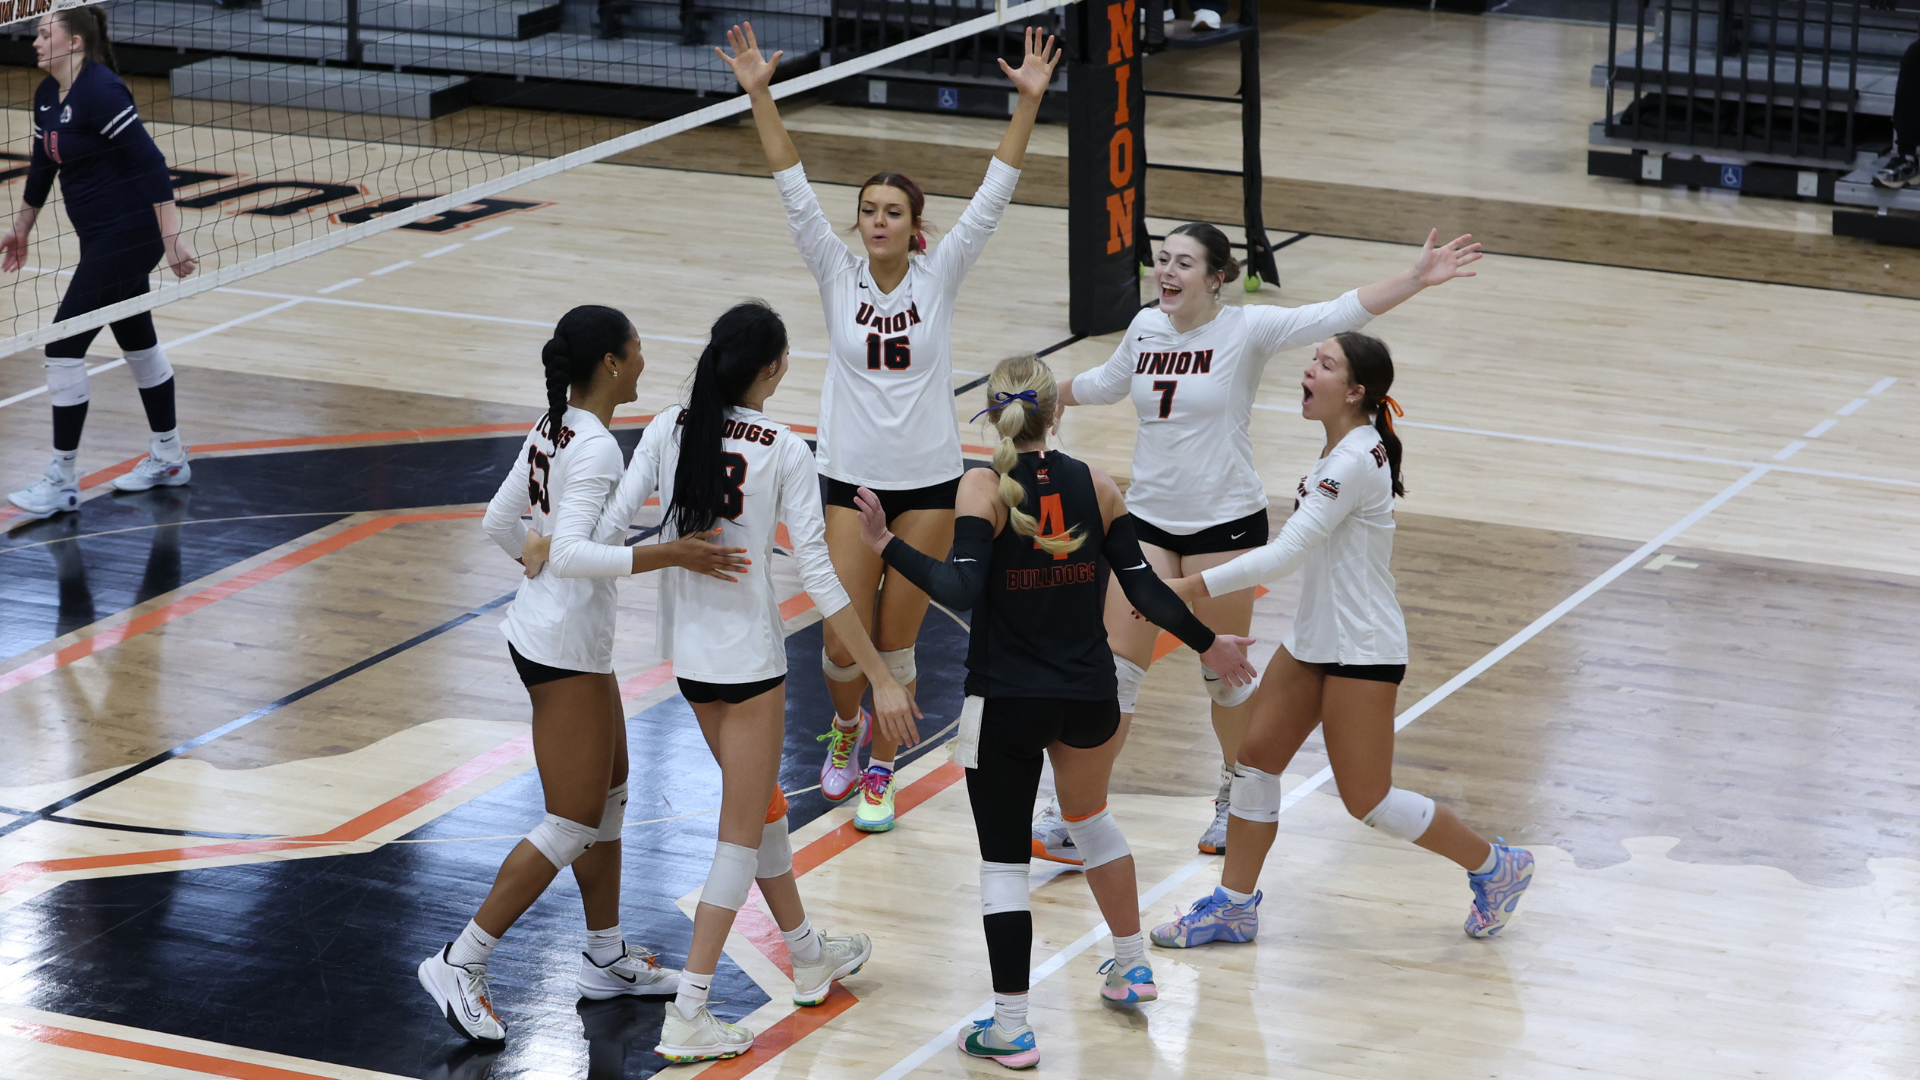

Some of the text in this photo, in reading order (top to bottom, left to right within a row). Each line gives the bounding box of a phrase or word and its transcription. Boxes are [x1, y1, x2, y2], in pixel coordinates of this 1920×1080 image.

[855, 301, 922, 335] UNION
[866, 332, 912, 371] 16
[1134, 348, 1215, 376] UNION
[1152, 380, 1178, 420] 7
[675, 408, 778, 447] BDOGS
[1033, 492, 1071, 561] 4
[1006, 561, 1096, 590] BULLDOGS
